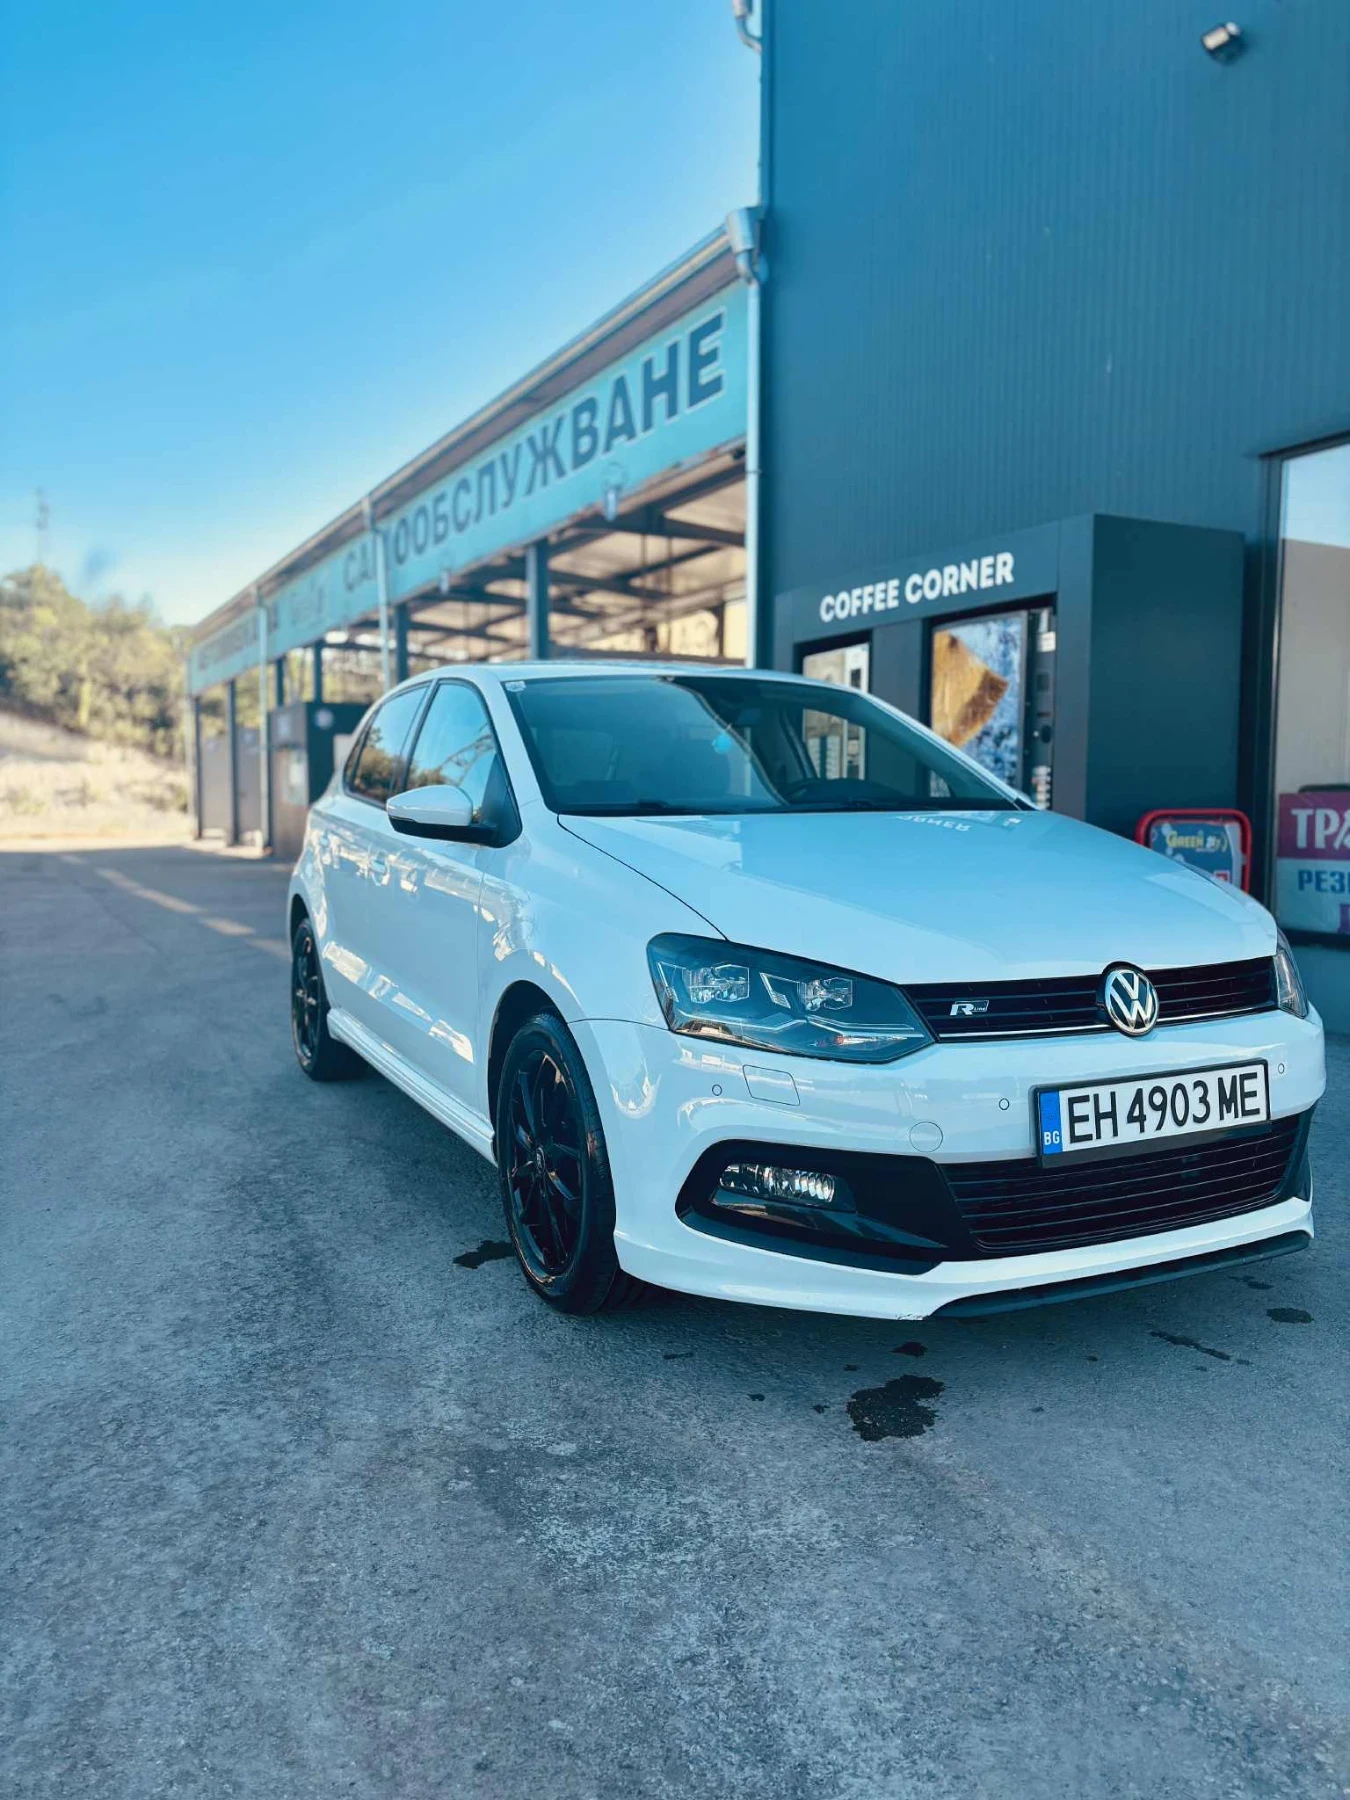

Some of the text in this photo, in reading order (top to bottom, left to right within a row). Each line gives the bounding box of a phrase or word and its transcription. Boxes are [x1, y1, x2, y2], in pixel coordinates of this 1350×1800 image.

[819, 551, 1014, 623] COFFEE CORNER
[1298, 869, 1350, 893] РЕЗ
[1067, 1072, 1260, 1144] EH 4903 ME
[1043, 1130, 1060, 1145] BG
